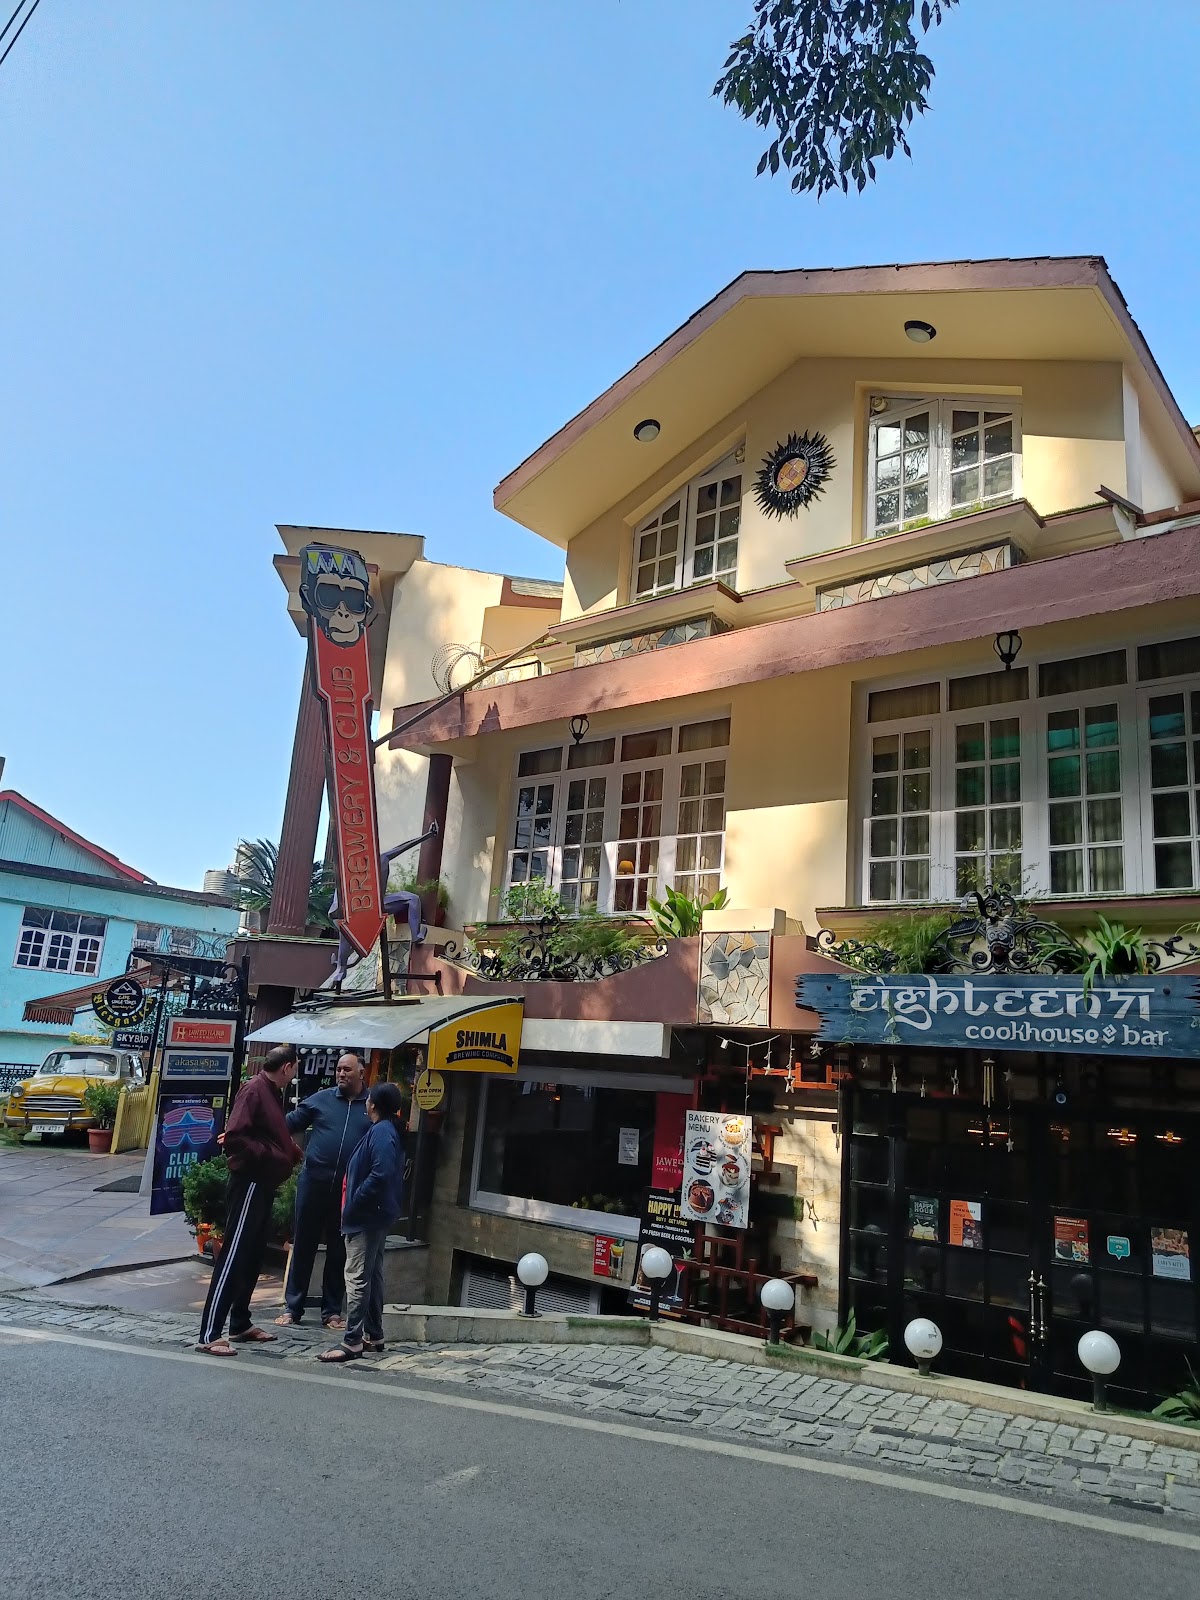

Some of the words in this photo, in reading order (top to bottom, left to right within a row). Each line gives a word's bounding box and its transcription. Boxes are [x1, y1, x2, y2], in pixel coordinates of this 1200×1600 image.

[332, 665, 358, 739] CLUB
[338, 744, 362, 765] &
[342, 774, 374, 913] BREWERY
[456, 1030, 507, 1051] SHIMLA
[965, 1021, 1099, 1044] cookhouse
[1121, 1024, 1169, 1046] bar
[453, 1050, 480, 1060] BREWING
[481, 1050, 508, 1062] COMPANY
[688, 1113, 720, 1124] BAKERY
[688, 1123, 711, 1133] MENU
[169, 1152, 198, 1165] CLUB
[648, 1200, 673, 1217] HAPPY
[914, 1201, 935, 1210] HAPPY
[914, 1207, 934, 1215] HOUR
